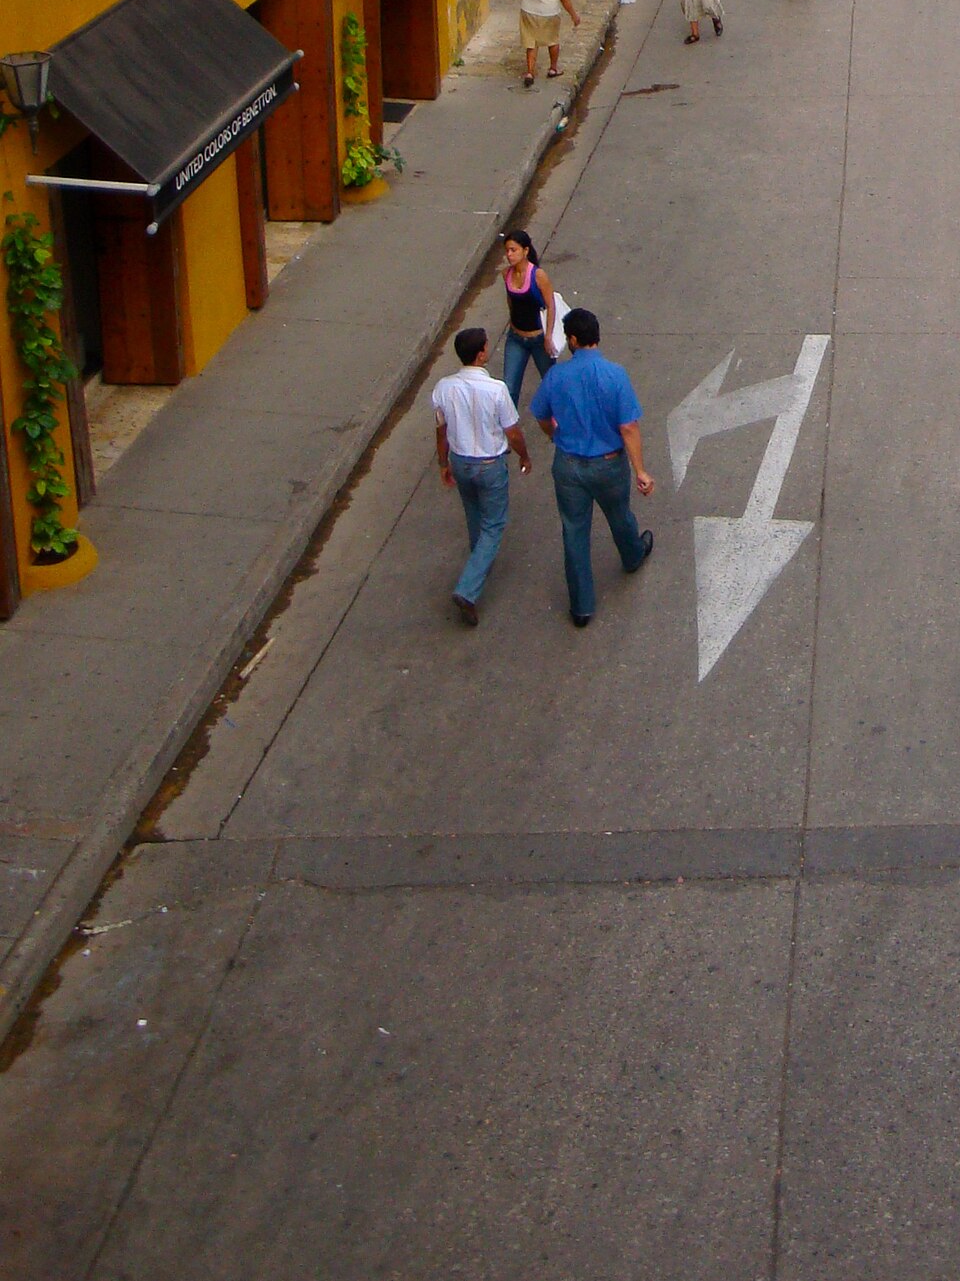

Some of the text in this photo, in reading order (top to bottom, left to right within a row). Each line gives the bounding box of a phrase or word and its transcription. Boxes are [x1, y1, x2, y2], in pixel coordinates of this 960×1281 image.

[175, 153, 204, 190] UNITED
[204, 125, 232, 162] COLORS
[231, 116, 242, 136] OF
